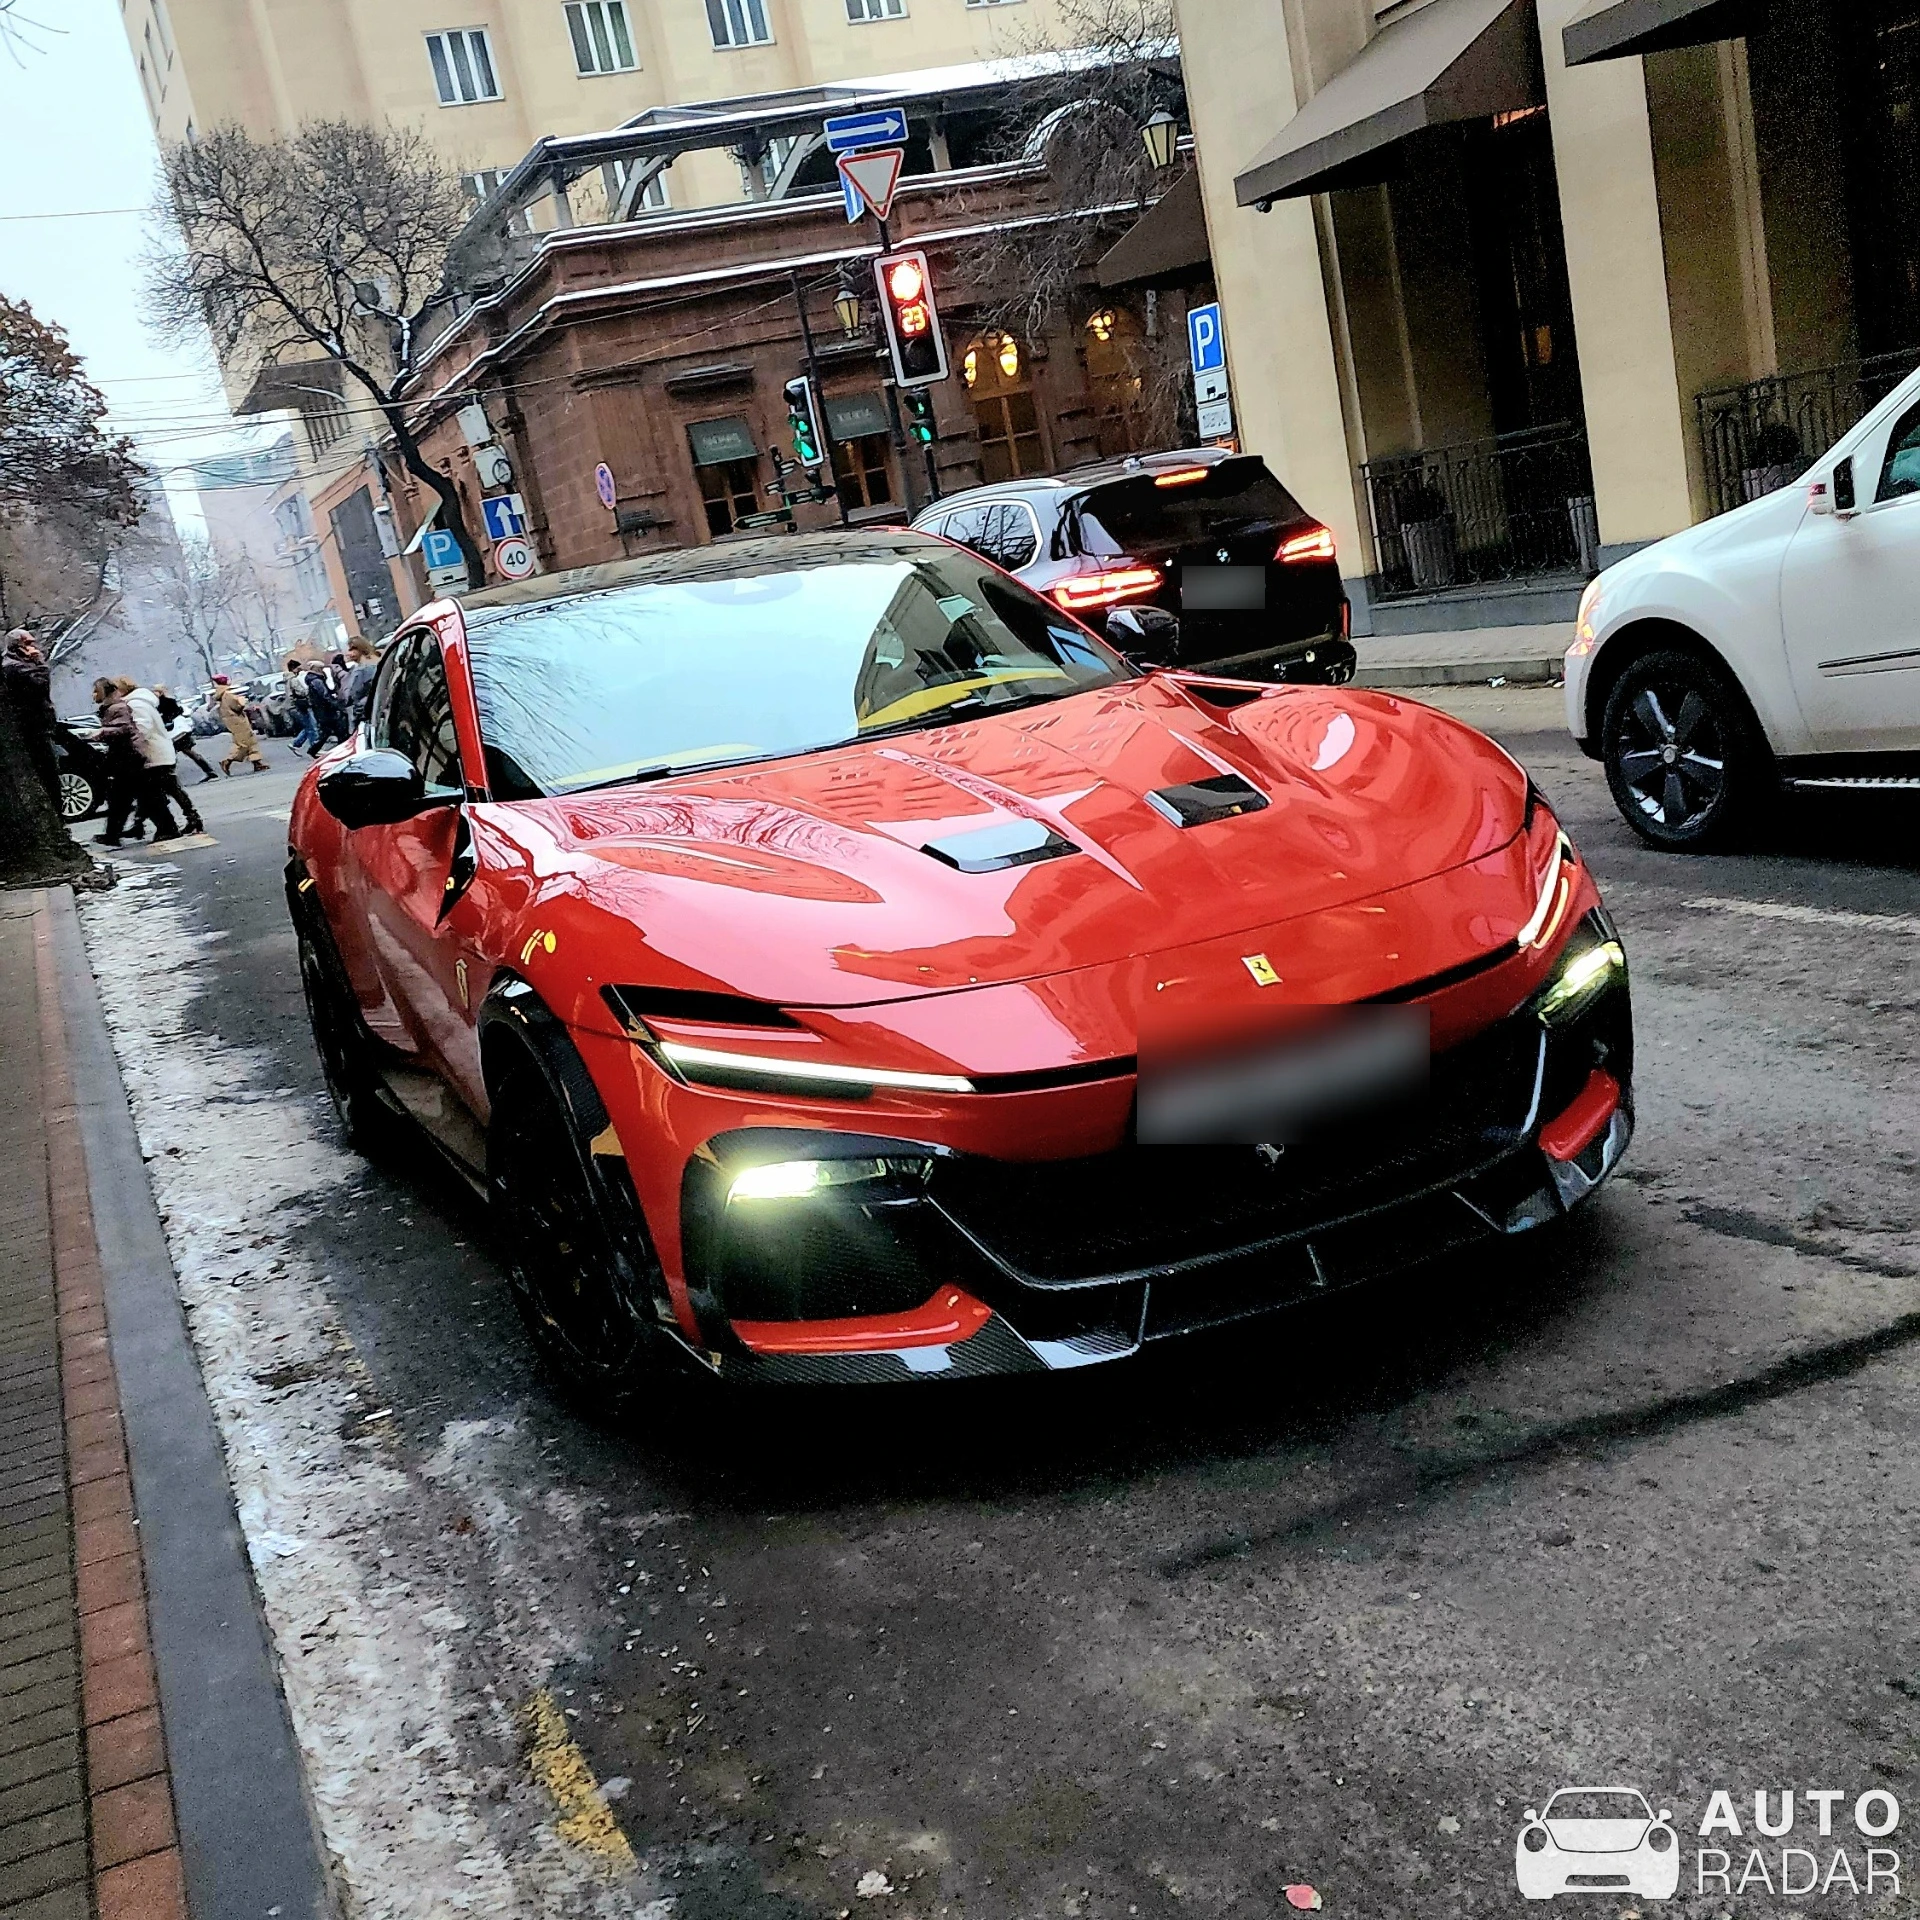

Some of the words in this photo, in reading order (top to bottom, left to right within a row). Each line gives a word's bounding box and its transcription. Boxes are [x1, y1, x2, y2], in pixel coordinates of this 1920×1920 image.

[1195, 314, 1214, 368] P
[428, 534, 452, 566] P
[506, 550, 527, 567] 40
